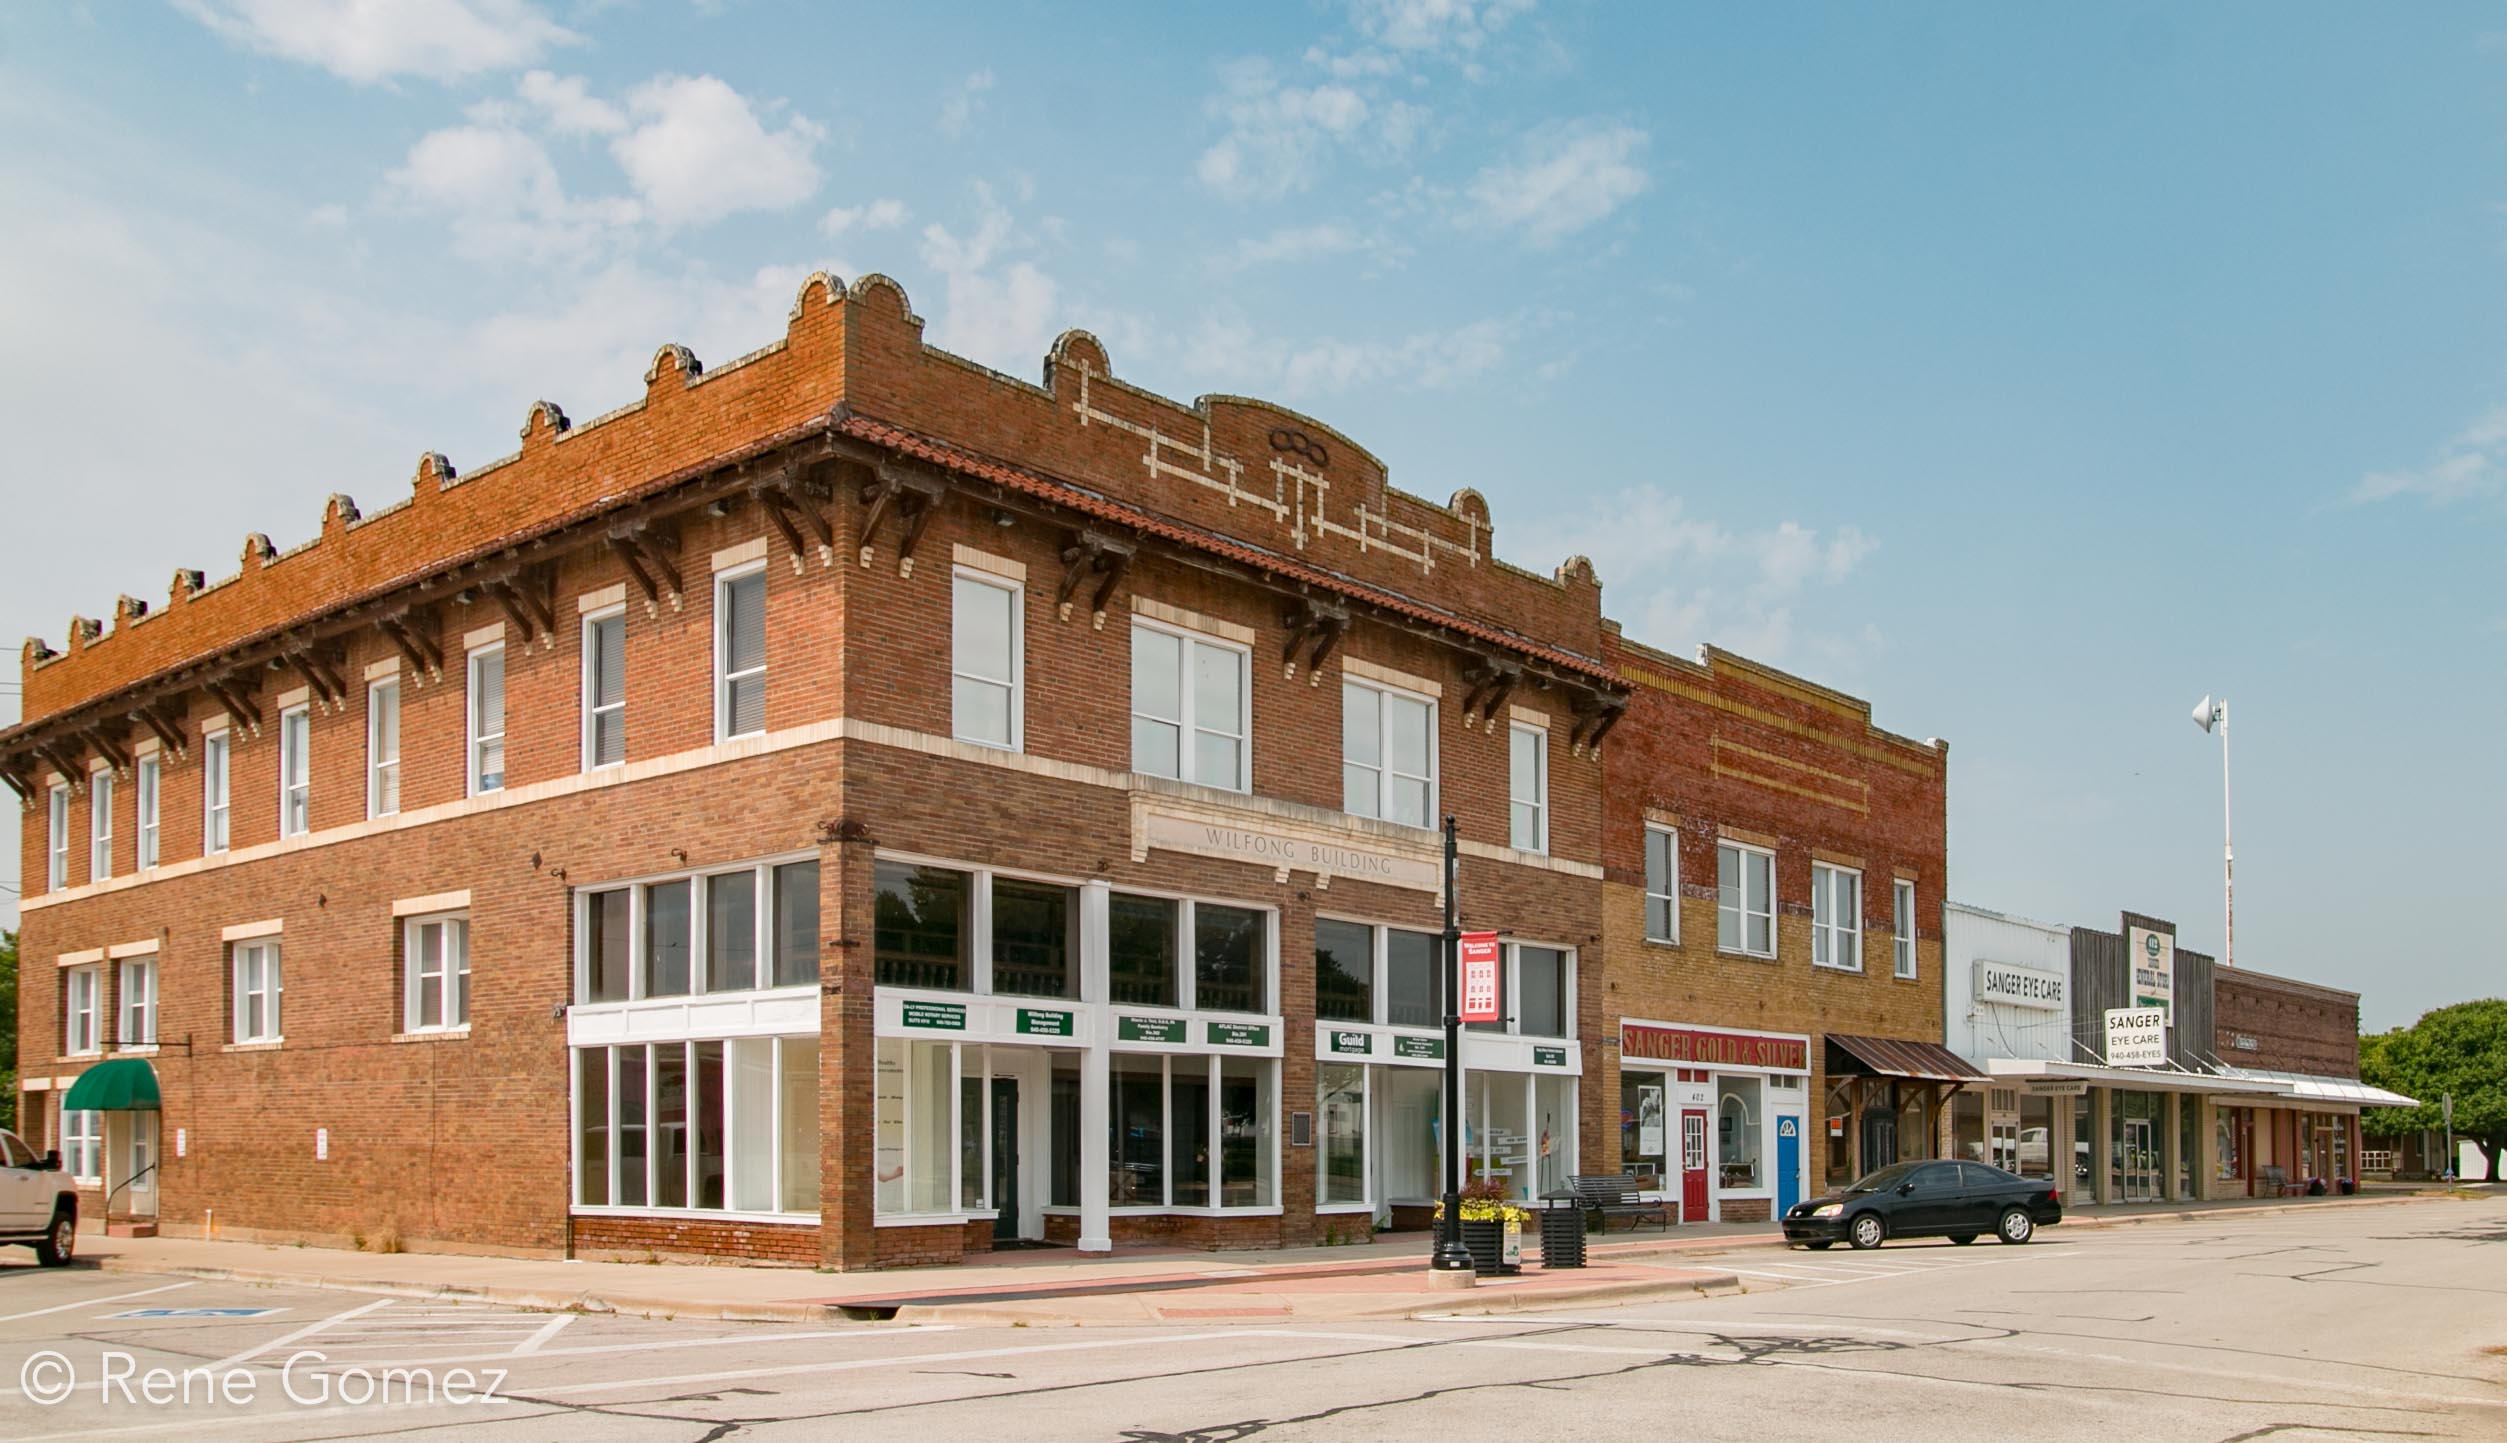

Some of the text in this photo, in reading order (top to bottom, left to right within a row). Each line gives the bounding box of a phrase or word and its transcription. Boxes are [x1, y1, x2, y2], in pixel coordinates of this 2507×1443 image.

[1206, 830, 1391, 874] WILFONG BUILDING
[1986, 970, 2061, 1002] SANGER EYE CARE
[2110, 1014, 2160, 1029] SANGER
[1338, 1032, 1365, 1047] Guild
[2111, 1034, 2160, 1046] EYE CARE
[1339, 1046, 1365, 1054] mortgage
[1623, 1030, 1807, 1070] SANGER GOLD & SILVER
[2110, 1050, 2161, 1060] 940-458-EYES
